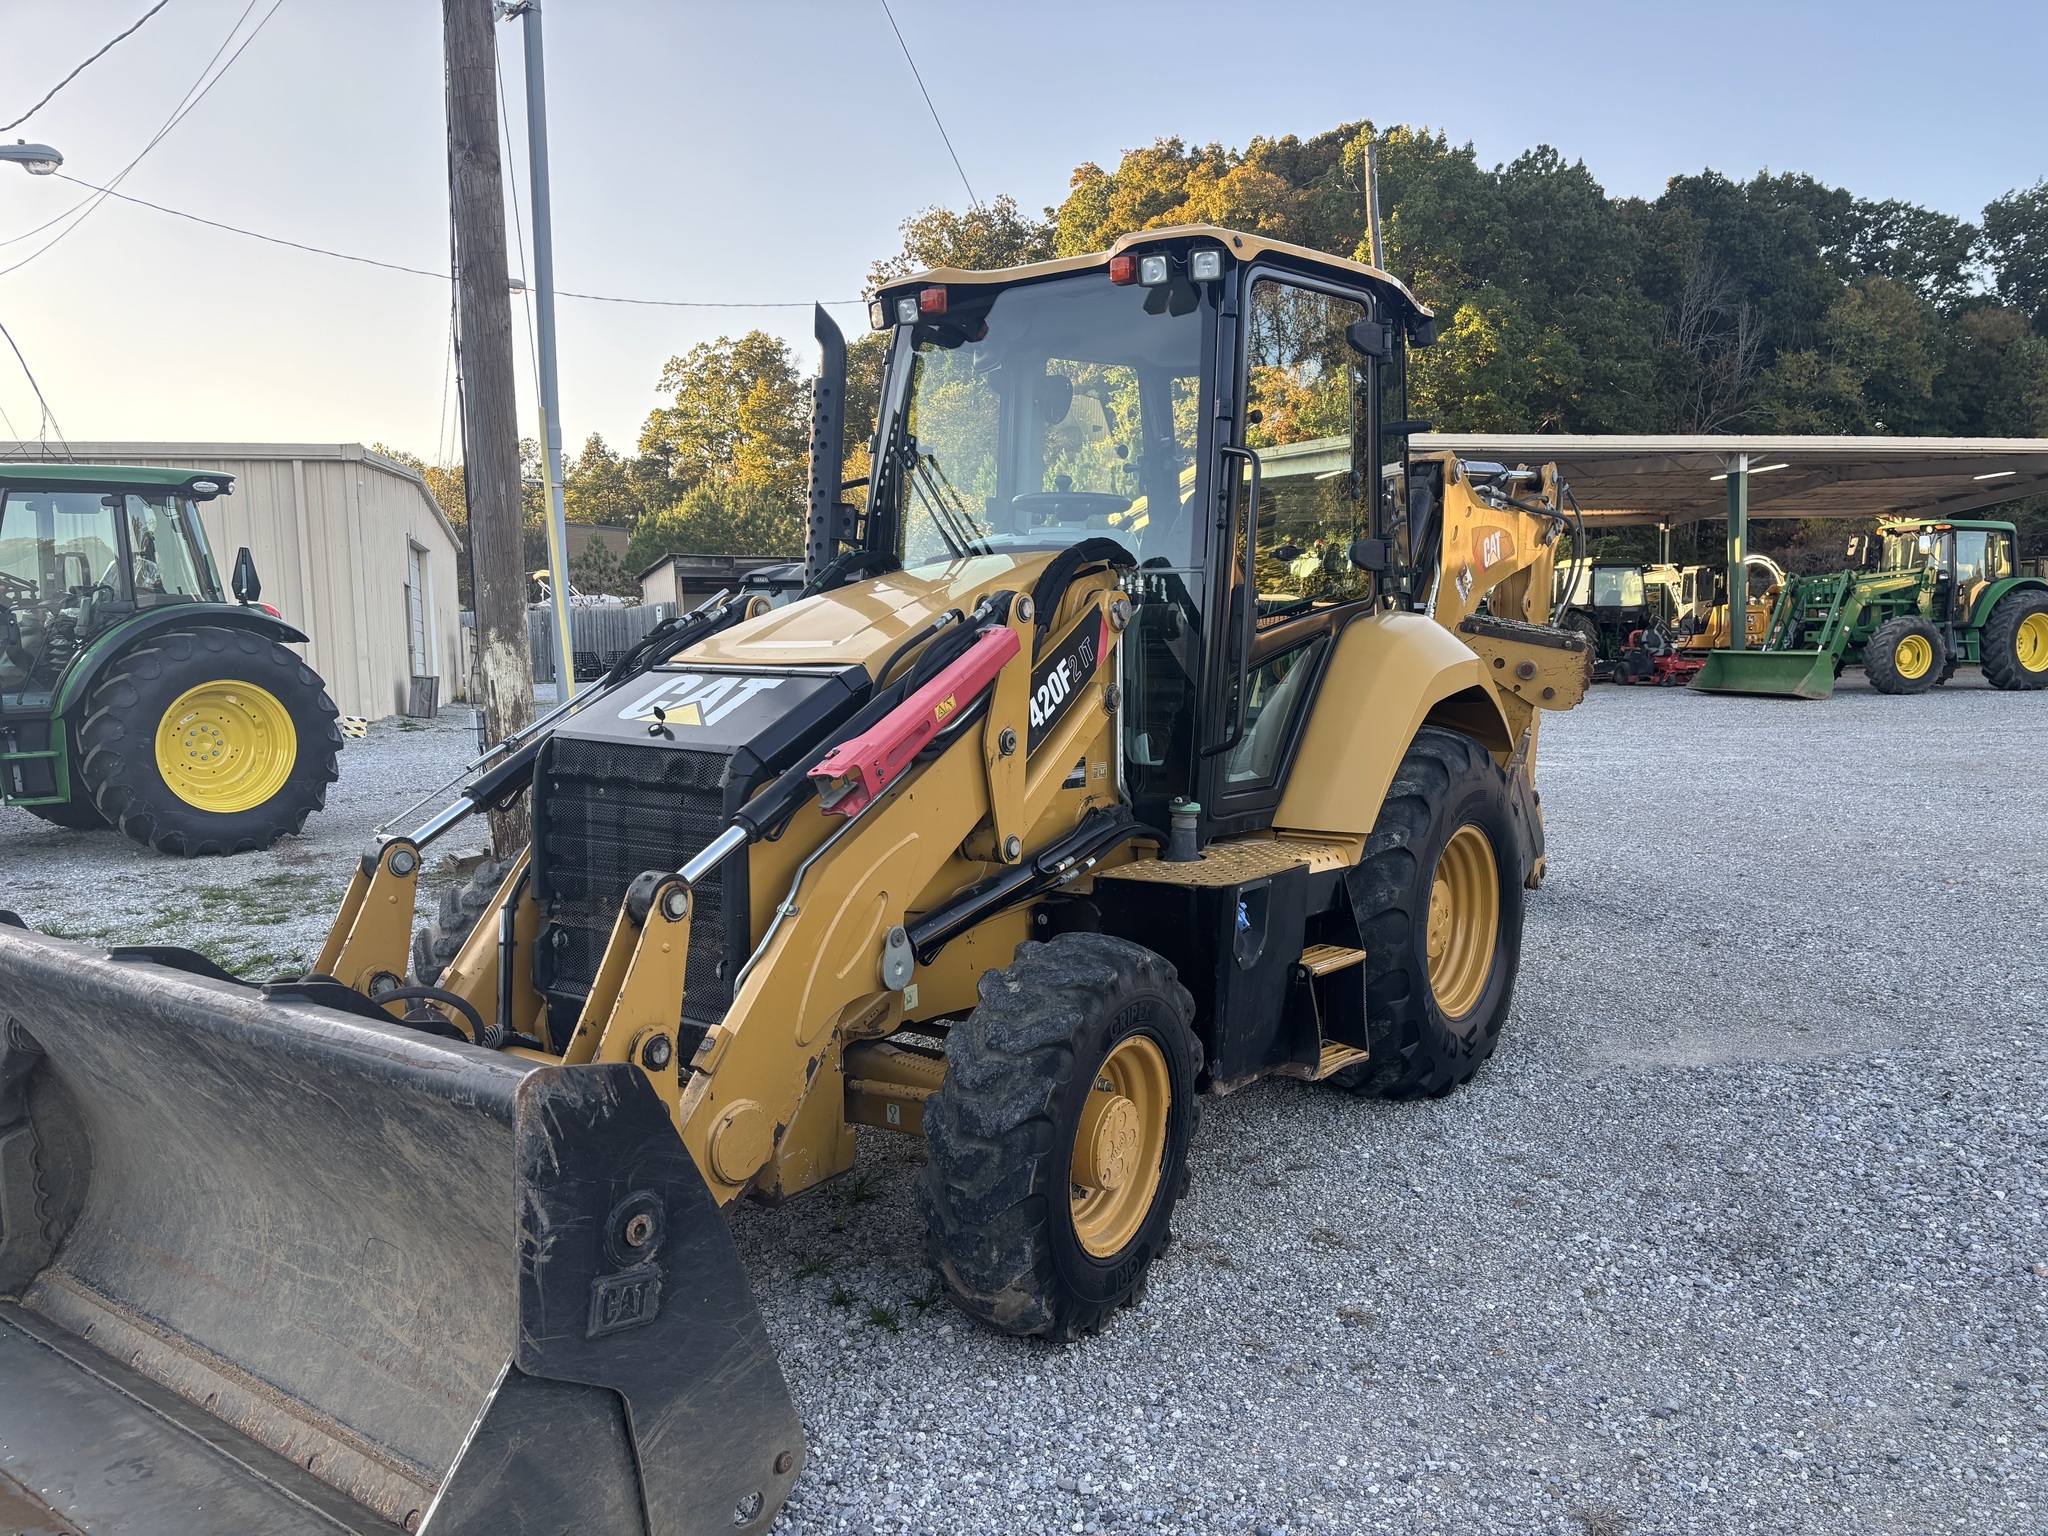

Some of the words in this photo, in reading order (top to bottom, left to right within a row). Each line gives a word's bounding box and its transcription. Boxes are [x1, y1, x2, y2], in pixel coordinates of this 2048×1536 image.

[1483, 530, 1501, 568] CAT
[617, 674, 786, 727] CAT
[601, 1282, 651, 1327] CAT
